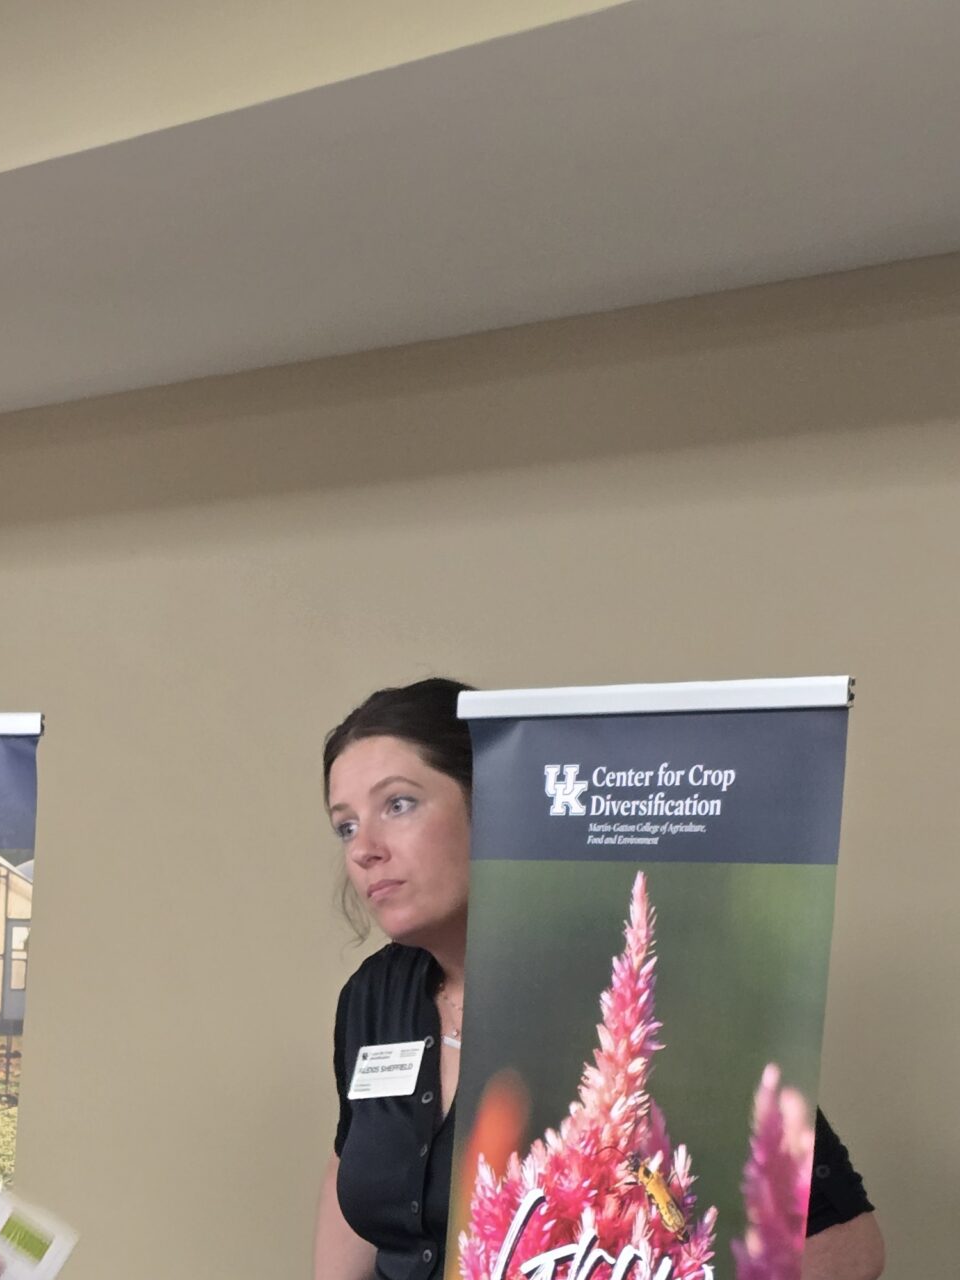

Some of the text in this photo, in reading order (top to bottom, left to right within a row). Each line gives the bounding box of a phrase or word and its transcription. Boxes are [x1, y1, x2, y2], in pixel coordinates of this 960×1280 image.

[592, 762, 736, 792] Center for Crop
[590, 792, 722, 816] Diversification
[587, 834, 660, 845] Food and Environment
